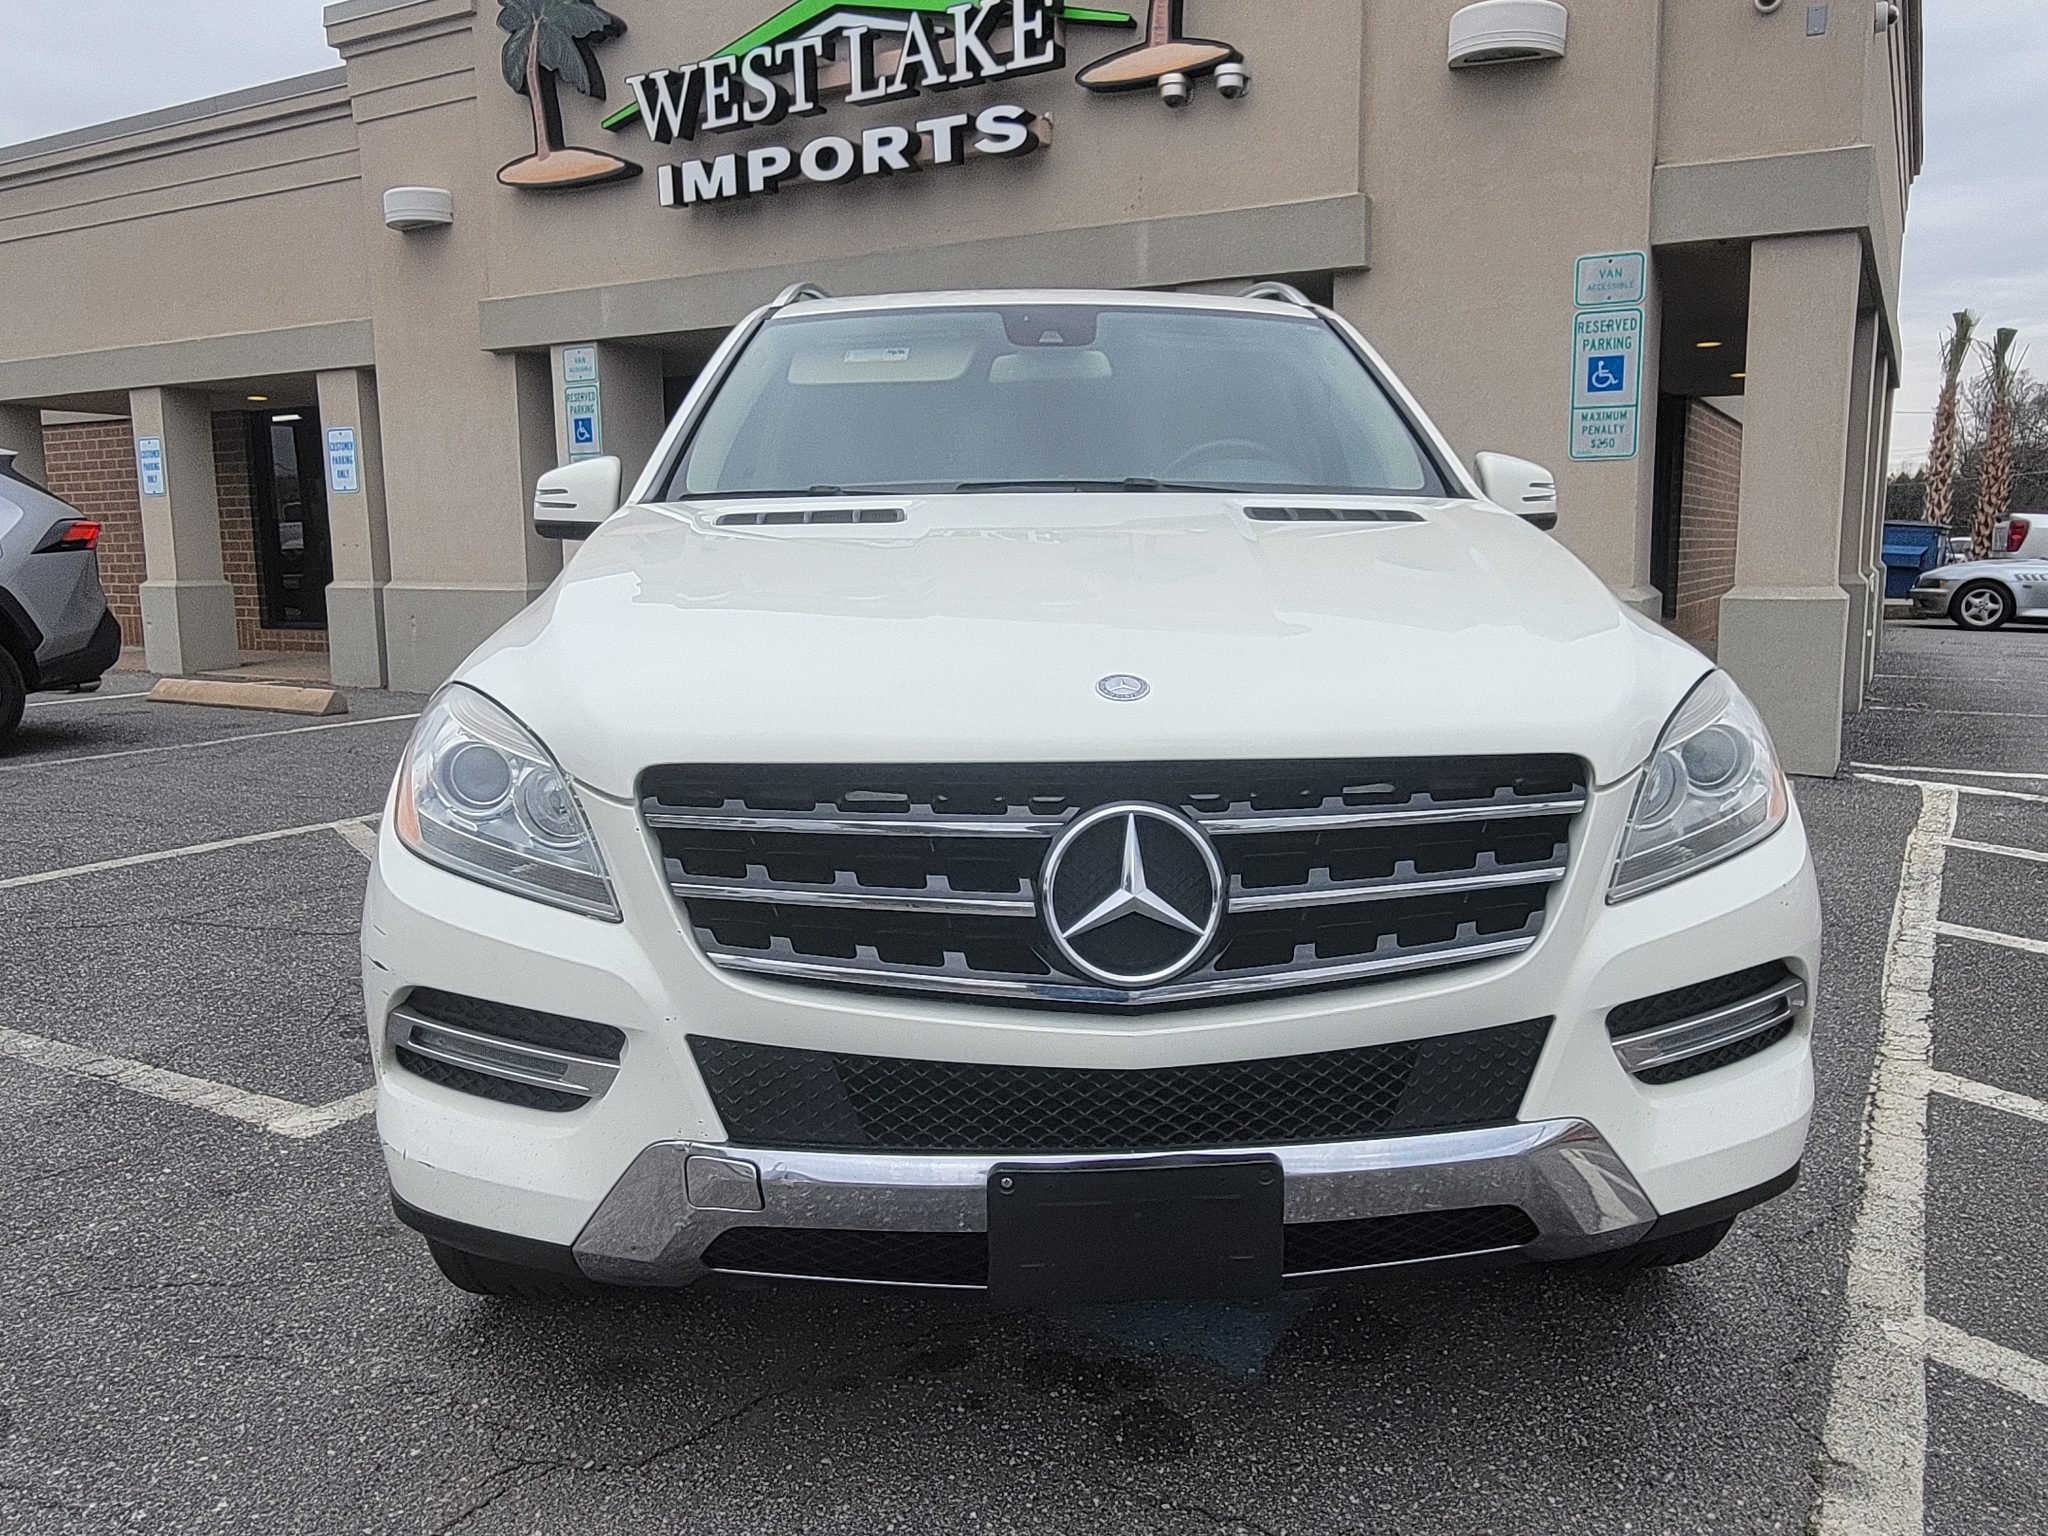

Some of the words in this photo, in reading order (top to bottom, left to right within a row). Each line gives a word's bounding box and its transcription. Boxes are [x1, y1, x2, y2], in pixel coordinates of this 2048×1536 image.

[625, 36, 826, 142] WEST
[844, 0, 1055, 103] LAKE
[657, 105, 1029, 206] IMPORTS
[1599, 268, 1622, 279] VAN
[1577, 318, 1638, 335] RESERVED
[1582, 336, 1632, 351] PARKING
[567, 391, 596, 402] RESERVED
[570, 404, 594, 415] PARKING
[1581, 410, 1627, 422] MAXIMUM
[1581, 424, 1625, 435] PENALTY
[1590, 437, 1616, 449] $250
